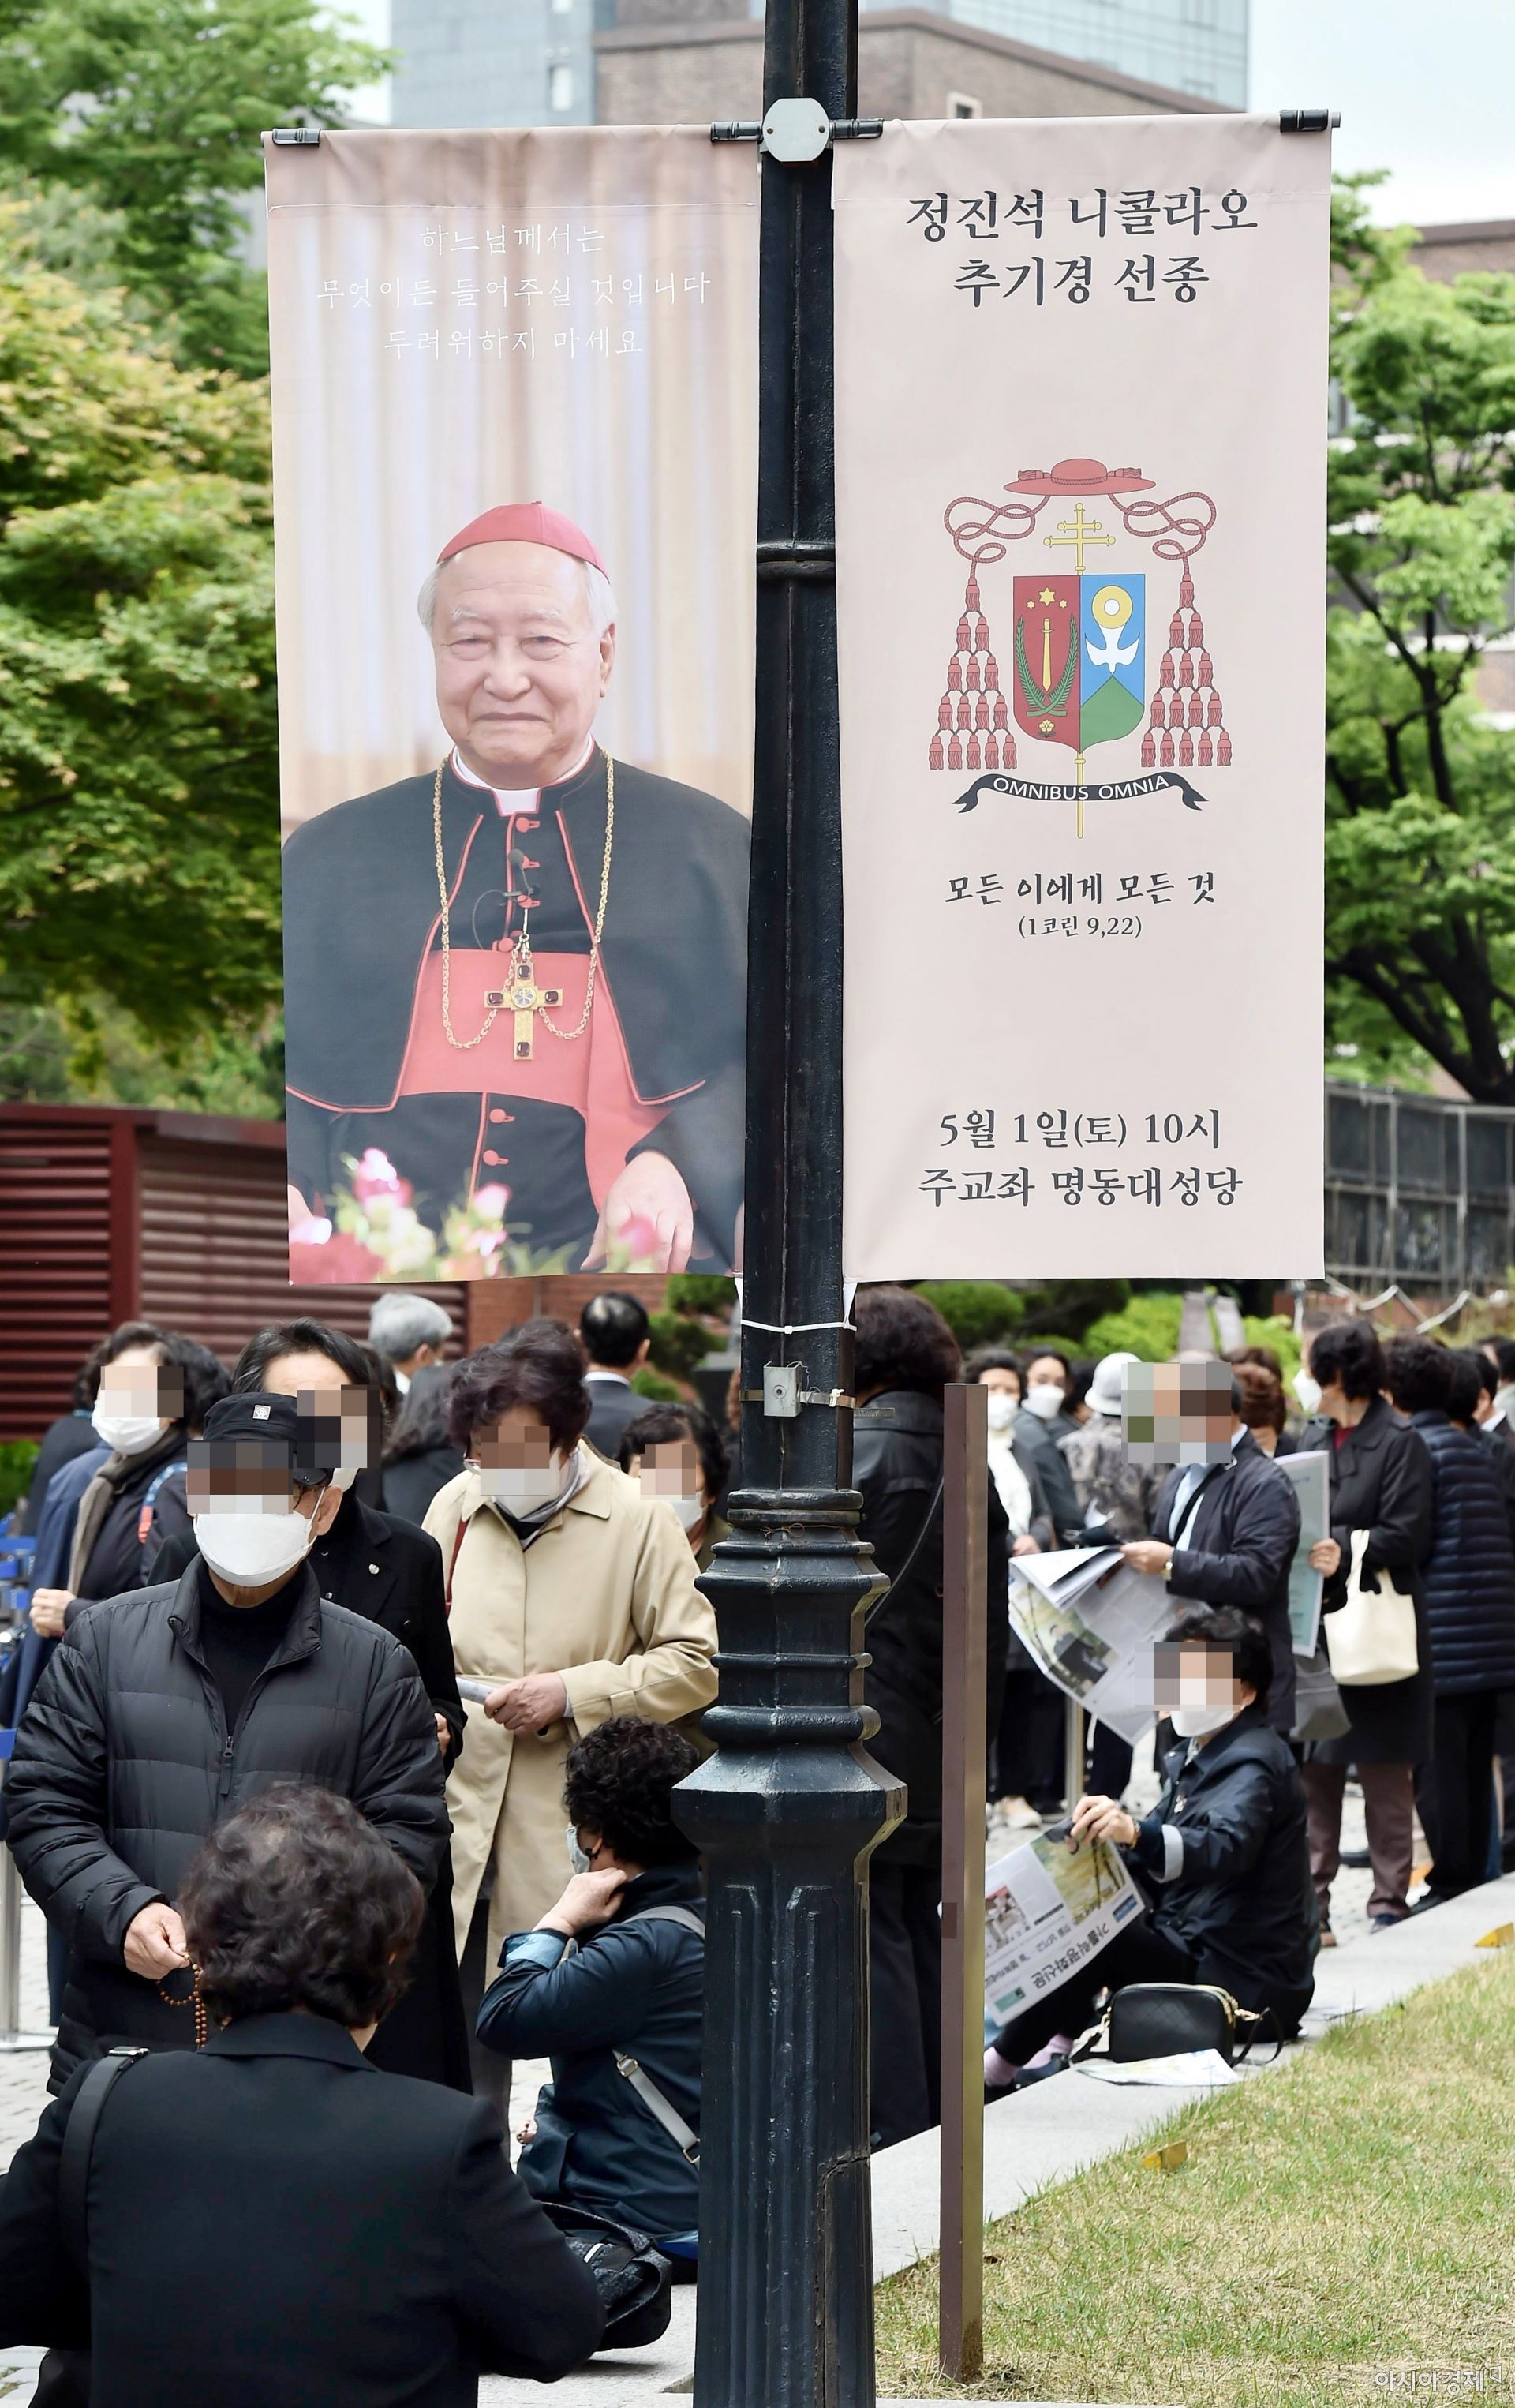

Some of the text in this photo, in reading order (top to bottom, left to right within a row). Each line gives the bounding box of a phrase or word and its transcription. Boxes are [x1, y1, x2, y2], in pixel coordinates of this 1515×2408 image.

[907, 187, 1257, 242] 정진석 니콜라오
[421, 223, 604, 255] 하느님께서는
[318, 272, 710, 308] 무엇이든 들어주실 것입니다
[953, 255, 1209, 307] 추기경 선종
[385, 327, 643, 360] 두려워하지 마세요
[993, 774, 1170, 801] OMNIBUS OMNIA
[945, 872, 1214, 904] 모든 이에게 모든 것
[1019, 916, 1141, 938] (1코린 9,22)
[941, 1109, 1218, 1148] 5월 1일(토) 10시
[919, 1167, 1243, 1207] 주교좌 명동대성당
